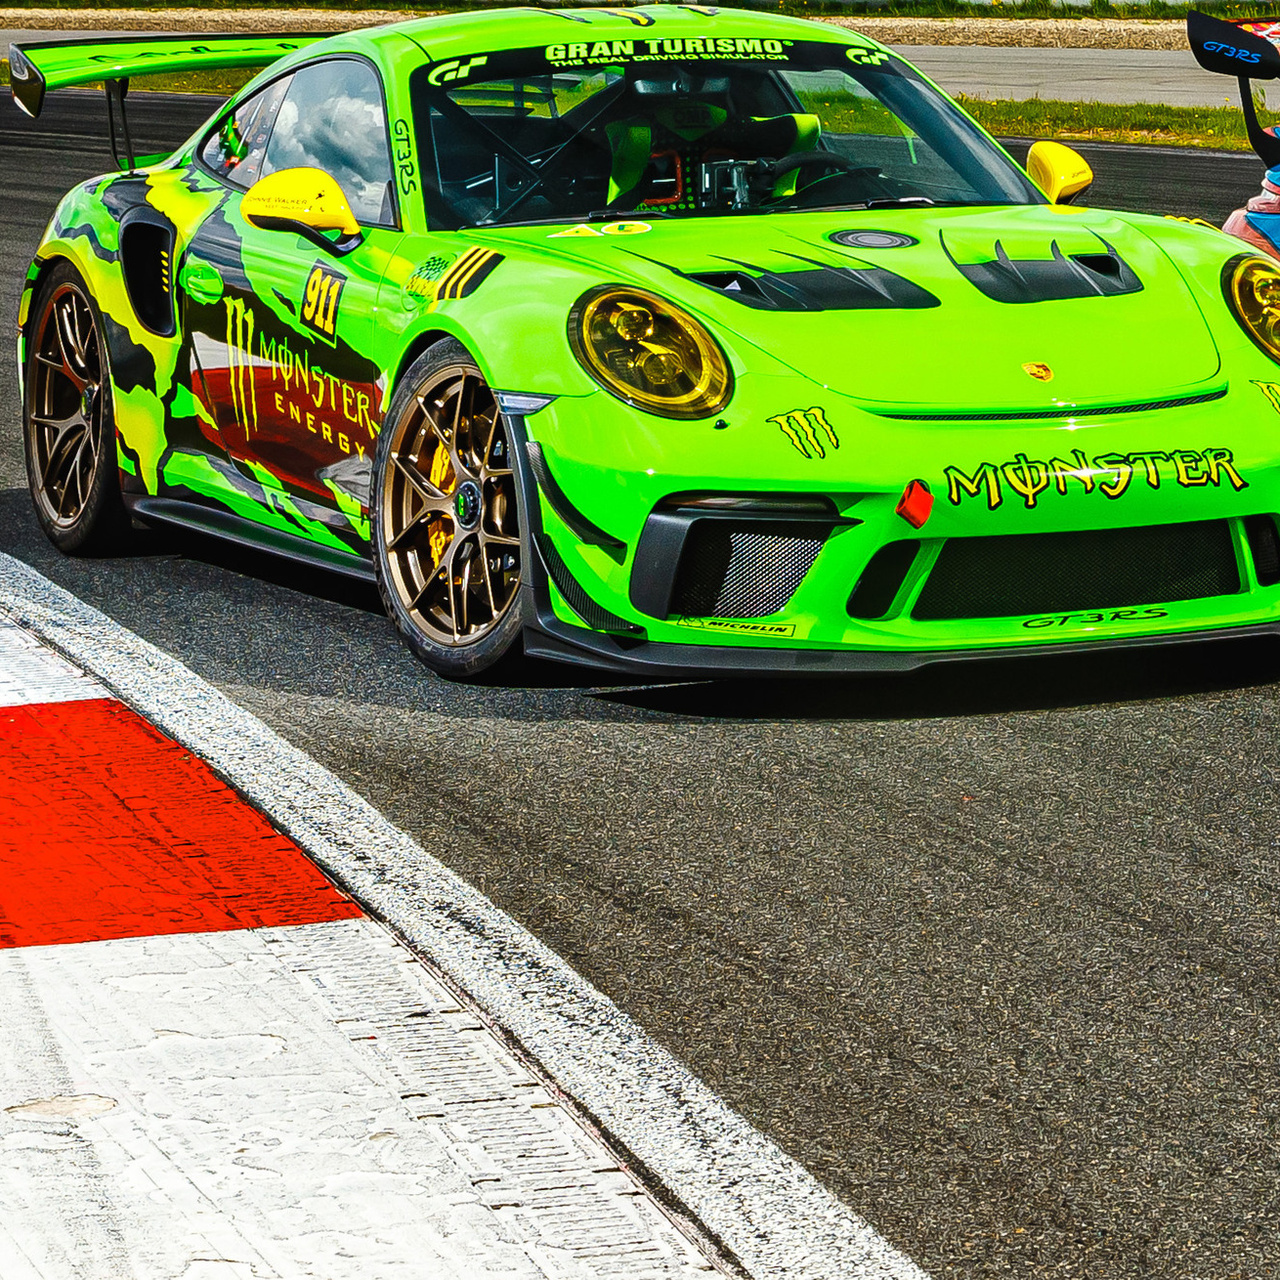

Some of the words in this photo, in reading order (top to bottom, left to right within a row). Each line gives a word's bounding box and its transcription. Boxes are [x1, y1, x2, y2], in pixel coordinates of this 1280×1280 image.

[544, 40, 635, 61] GRAN
[550, 58, 585, 67] THE
[587, 56, 630, 64] REAL
[634, 54, 698, 62] DRIVING
[1202, 41, 1262, 63] GT3RS
[394, 118, 417, 196] GT3RS
[303, 267, 341, 335] 911
[259, 330, 381, 439] MONSTER
[274, 392, 365, 462] ENERGY
[944, 448, 1250, 510] MONSTER
[708, 621, 788, 633] MICHELIN
[1022, 608, 1169, 629] GT3RS
